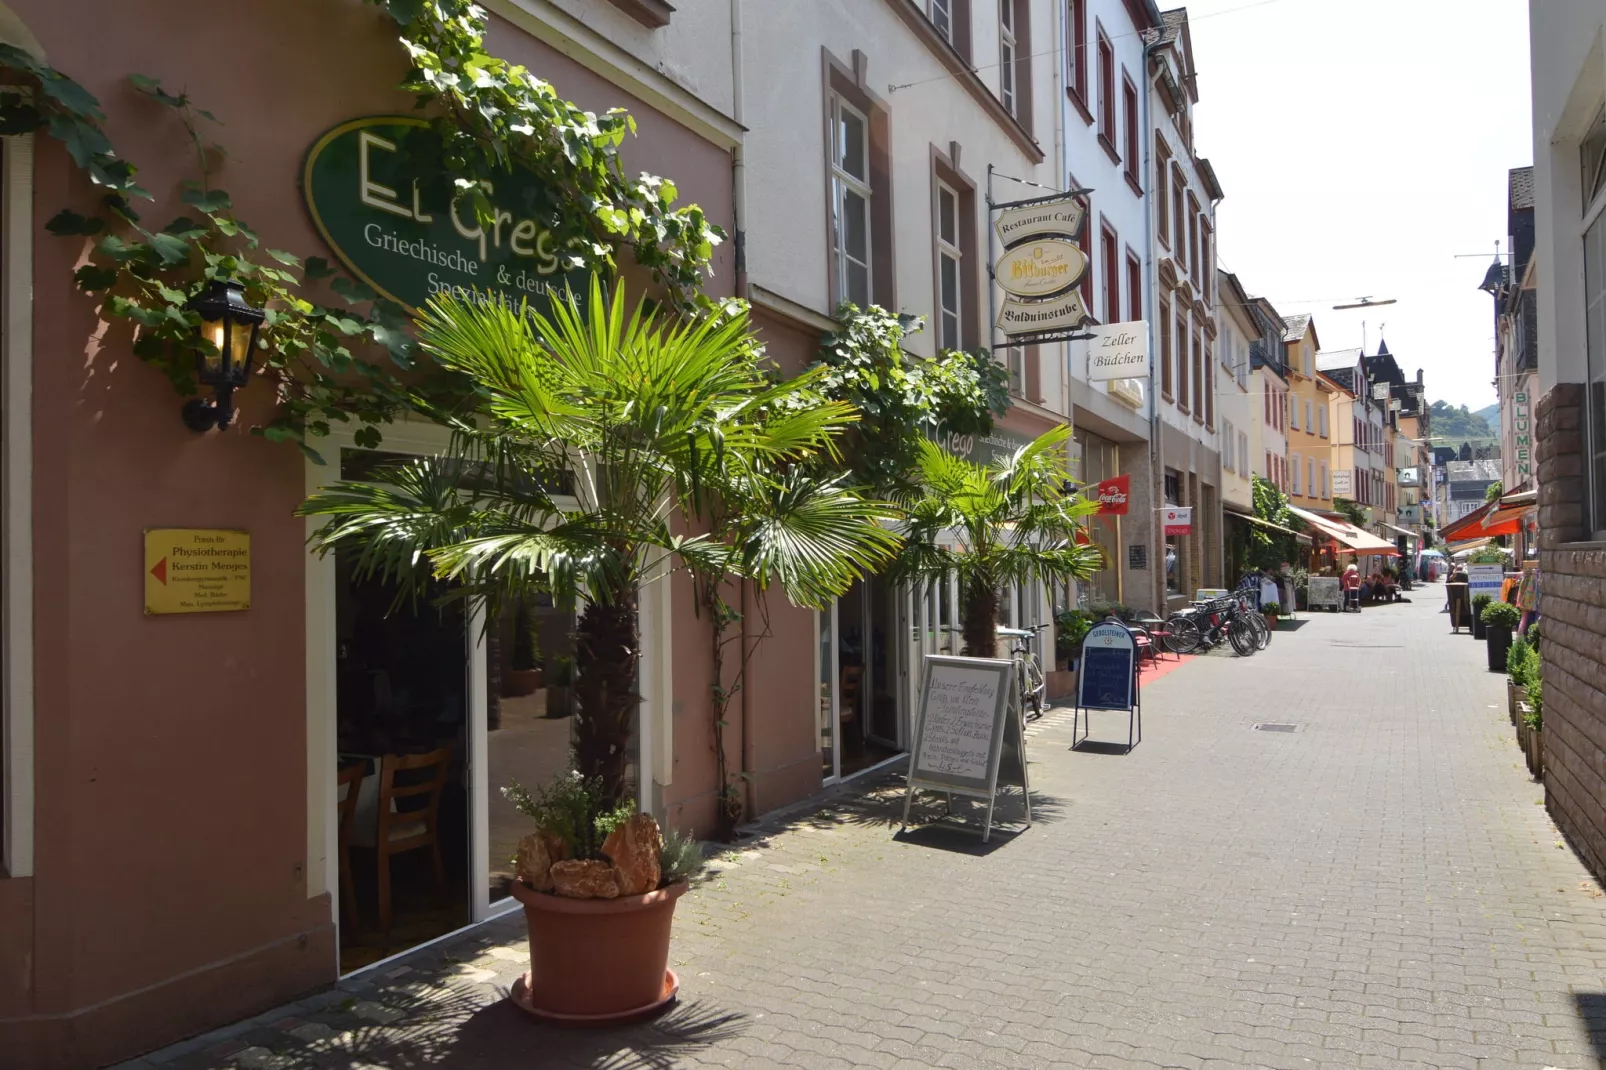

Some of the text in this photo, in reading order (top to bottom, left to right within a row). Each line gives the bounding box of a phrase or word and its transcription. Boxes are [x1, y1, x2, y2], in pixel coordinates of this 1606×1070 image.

[1002, 212, 1076, 234] Restaurant Café
[364, 222, 582, 307] Griechische & deutsce
[1012, 258, 1069, 280] Bitburger
[1004, 303, 1077, 322] Balduinstube
[1101, 332, 1137, 348] Zeller
[1093, 351, 1144, 367] Büdchen
[935, 417, 974, 459] Grego
[1516, 392, 1529, 474] BLUMEN
[194, 535, 214, 543] Praxis
[172, 546, 248, 558] Physiotherapie
[172, 562, 248, 573] Kerstin Menges
[1092, 629, 1126, 639] GEROLSTEINER
[930, 677, 958, 692] Unsere
